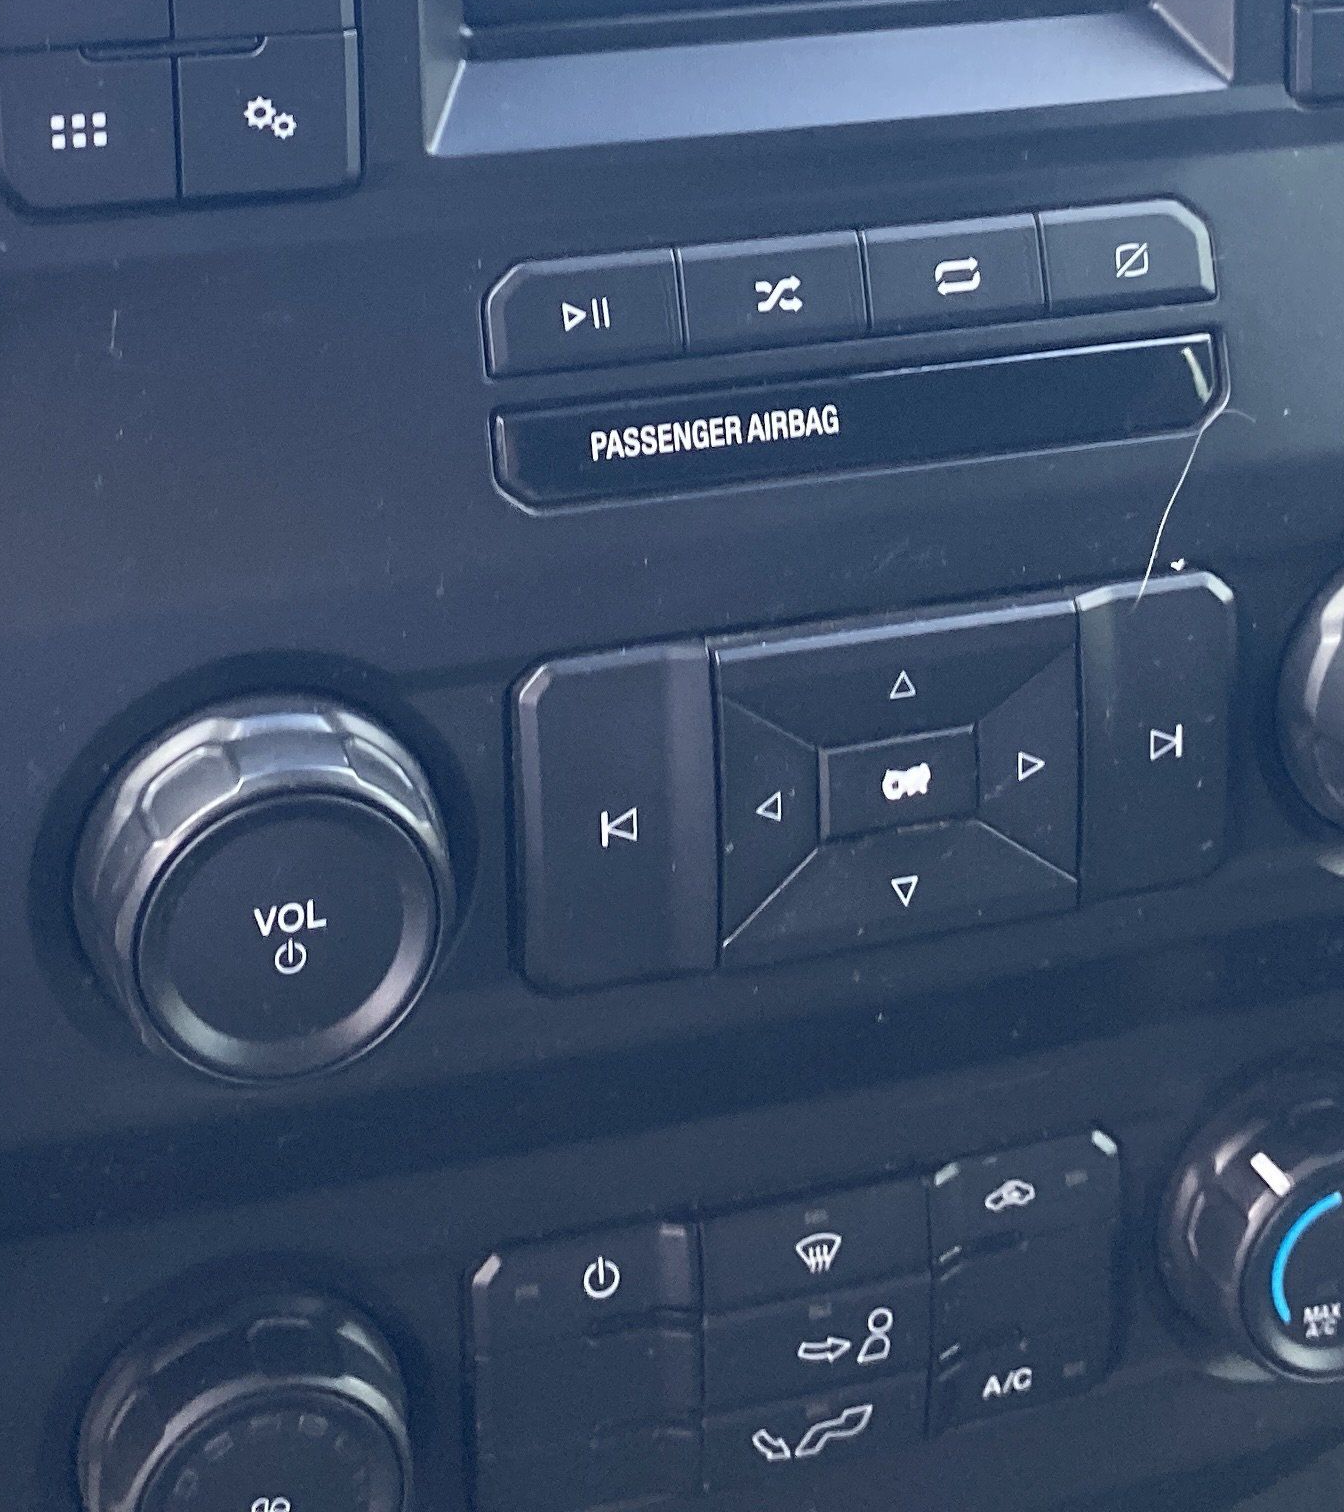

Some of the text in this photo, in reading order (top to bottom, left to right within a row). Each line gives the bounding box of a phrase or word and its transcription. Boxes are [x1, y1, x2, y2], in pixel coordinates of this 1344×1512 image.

[590, 403, 840, 461] PASSENGER AIRBAG
[253, 898, 327, 937] VOL
[982, 1367, 1033, 1398] A/C
